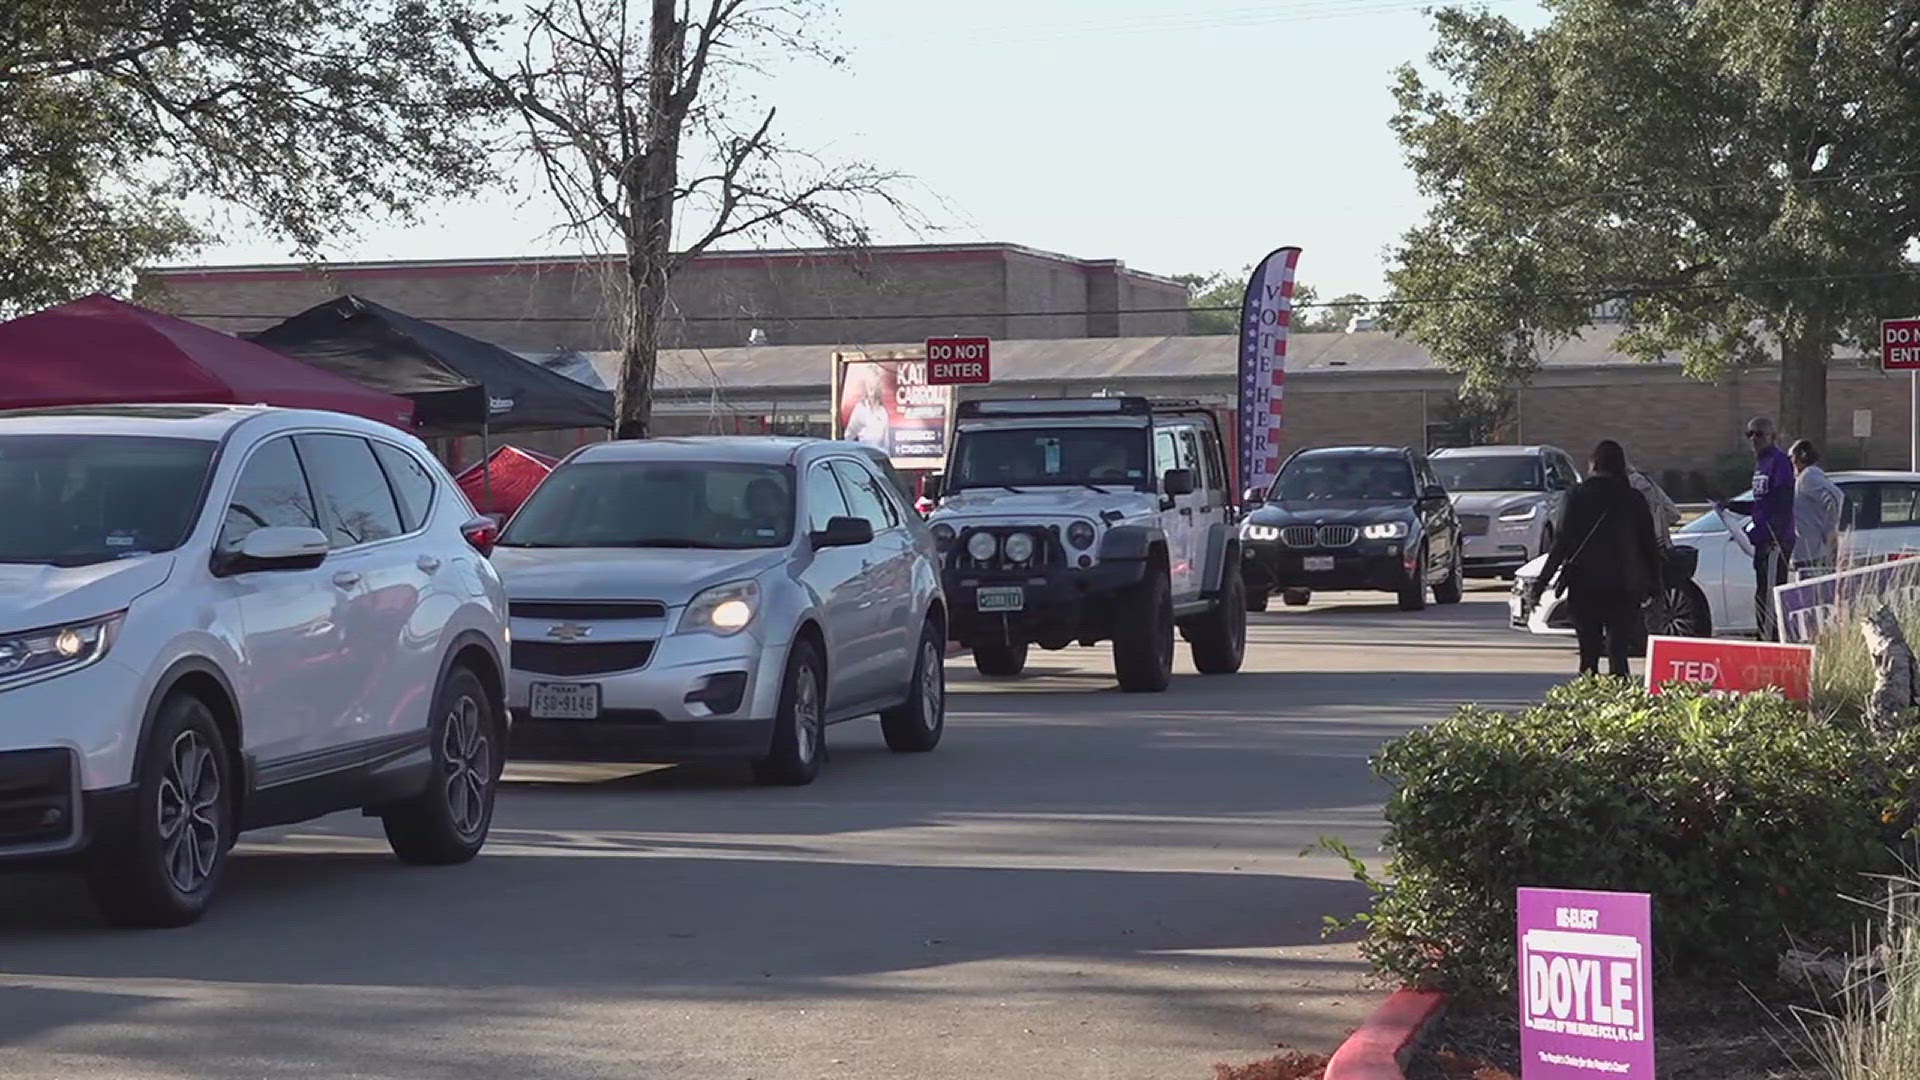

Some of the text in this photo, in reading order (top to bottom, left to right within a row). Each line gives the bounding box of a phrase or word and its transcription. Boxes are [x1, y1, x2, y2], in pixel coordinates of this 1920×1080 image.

[1887, 328, 1910, 343] DO
[930, 344, 986, 360] DO NOT
[1891, 347, 1920, 361] ENT
[934, 362, 983, 378] ENTER
[1253, 285, 1280, 475] VOTE HERE
[1669, 660, 1718, 682] TED
[1556, 907, 1598, 929] RE-ELECT
[1529, 954, 1634, 1026] DOYLE
